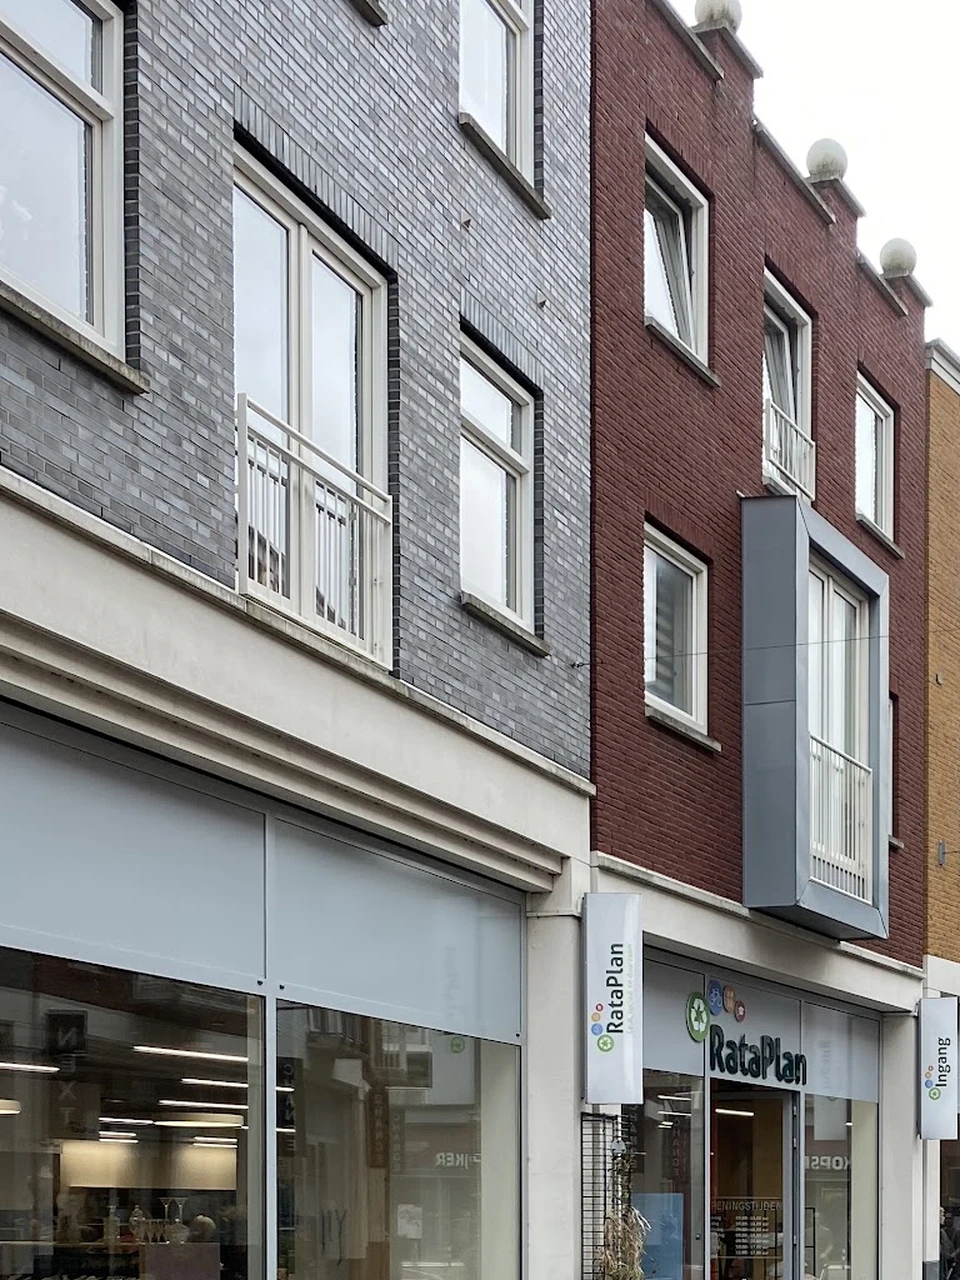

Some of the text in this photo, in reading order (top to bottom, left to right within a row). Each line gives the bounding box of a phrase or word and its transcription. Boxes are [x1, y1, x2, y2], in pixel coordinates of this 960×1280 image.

[606, 942, 624, 1034] RataPlan
[709, 1023, 807, 1086] RataPlan
[935, 1036, 951, 1087] Ingang
